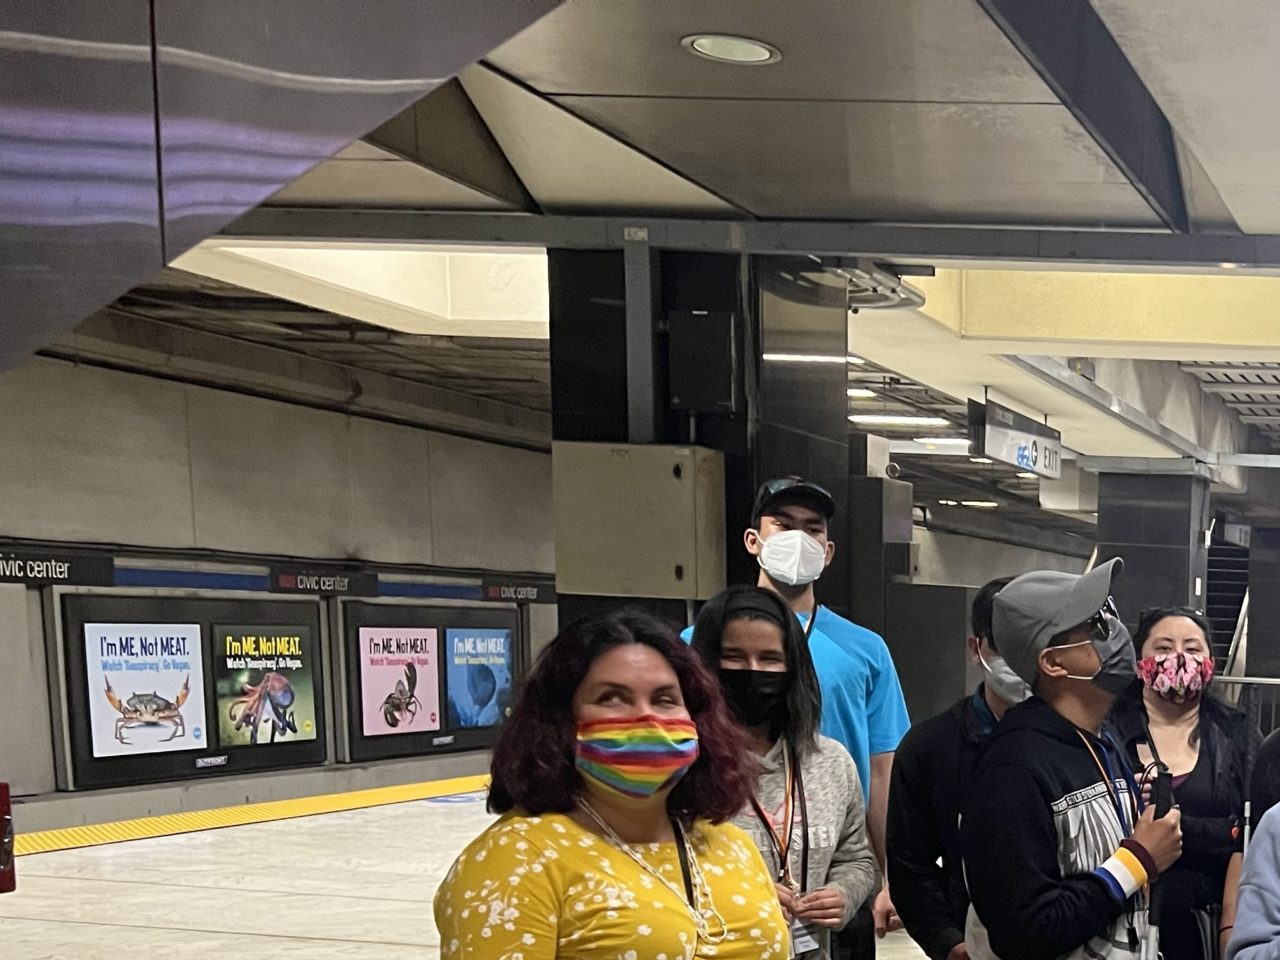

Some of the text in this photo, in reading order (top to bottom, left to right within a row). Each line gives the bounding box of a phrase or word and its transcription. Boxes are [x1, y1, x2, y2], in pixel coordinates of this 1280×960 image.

[1043, 445, 1058, 472] EXIT
[0, 553, 71, 579] ivic center
[297, 570, 349, 591] civic center
[100, 636, 190, 658] I'm ME, Not MEAT.
[226, 636, 302, 657] I'm ME, Not MEAT.
[369, 637, 380, 654] I'm
[396, 638, 408, 654] Not
[409, 638, 429, 654] MEAT.
